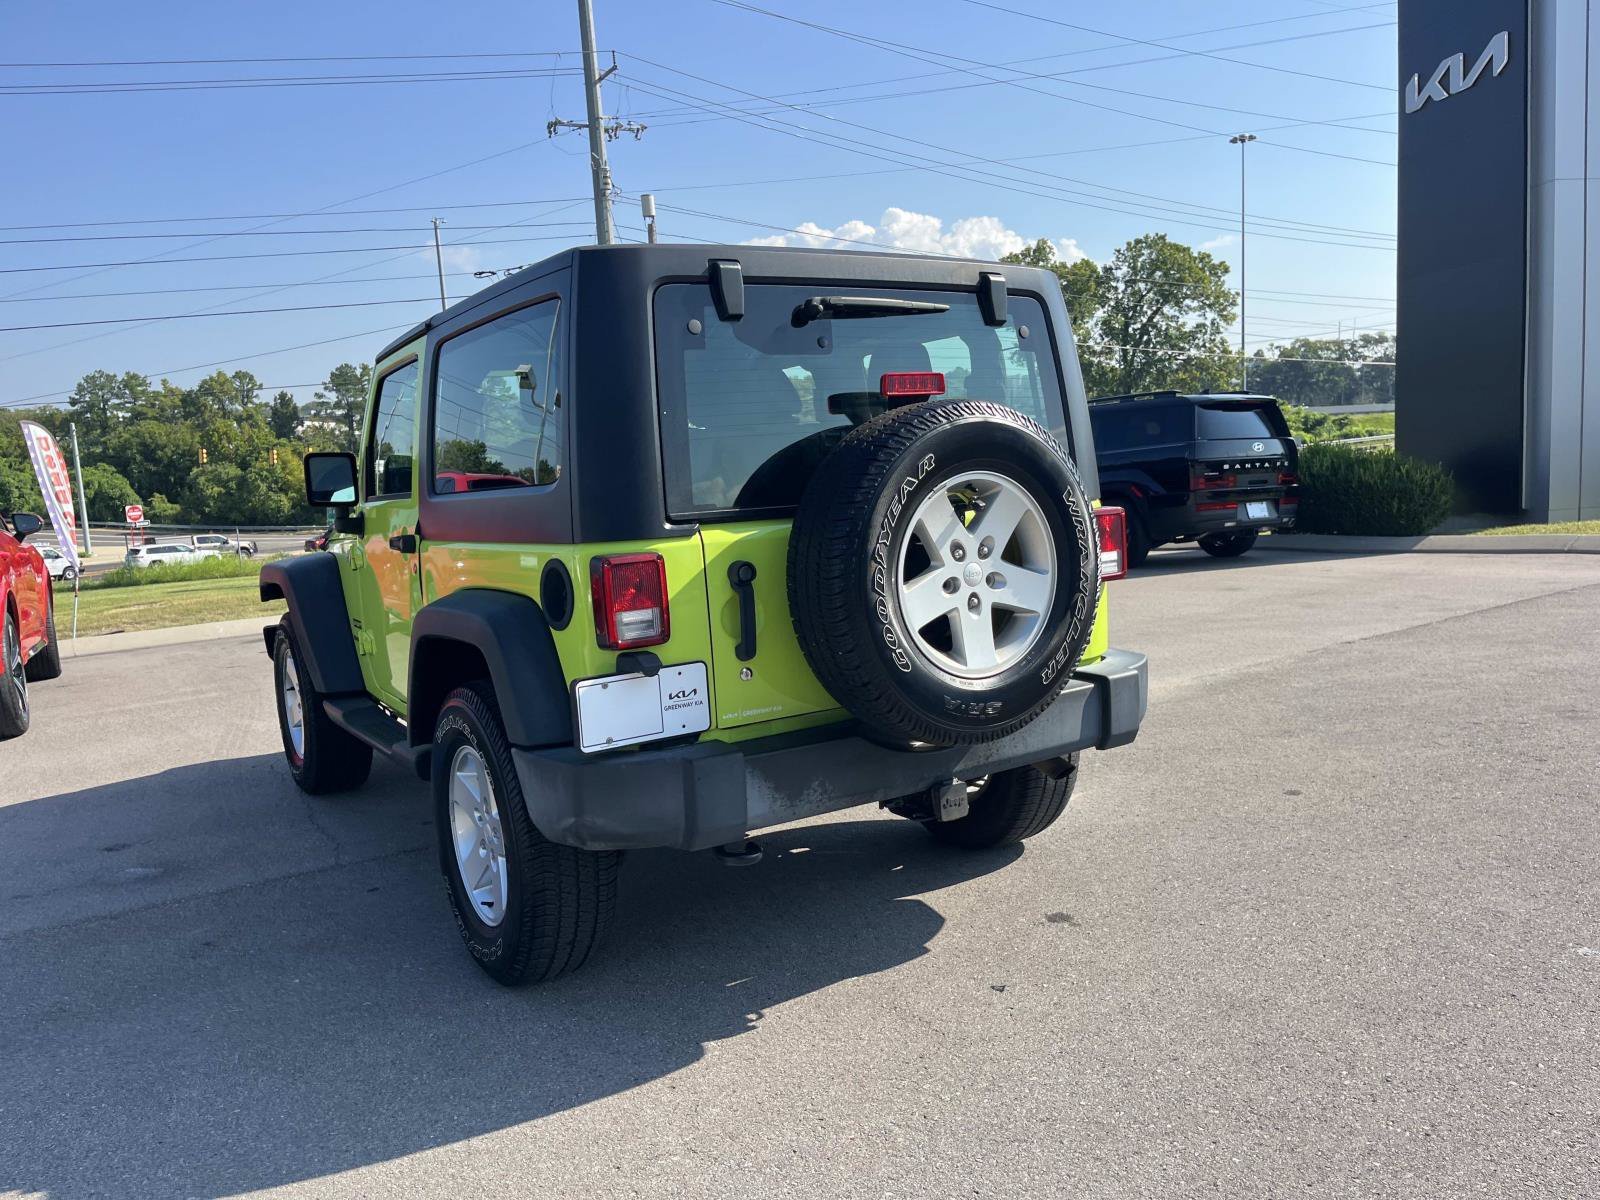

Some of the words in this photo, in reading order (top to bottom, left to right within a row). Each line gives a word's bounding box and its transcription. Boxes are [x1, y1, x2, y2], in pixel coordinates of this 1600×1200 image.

[1405, 30, 1509, 114] KIA
[1223, 462, 1270, 470] SANTA
[874, 453, 935, 673] GOODYEAR
[1041, 486, 1090, 685] WRANGLER
[663, 701, 693, 711] GREENWAY
[668, 688, 697, 700] KIA
